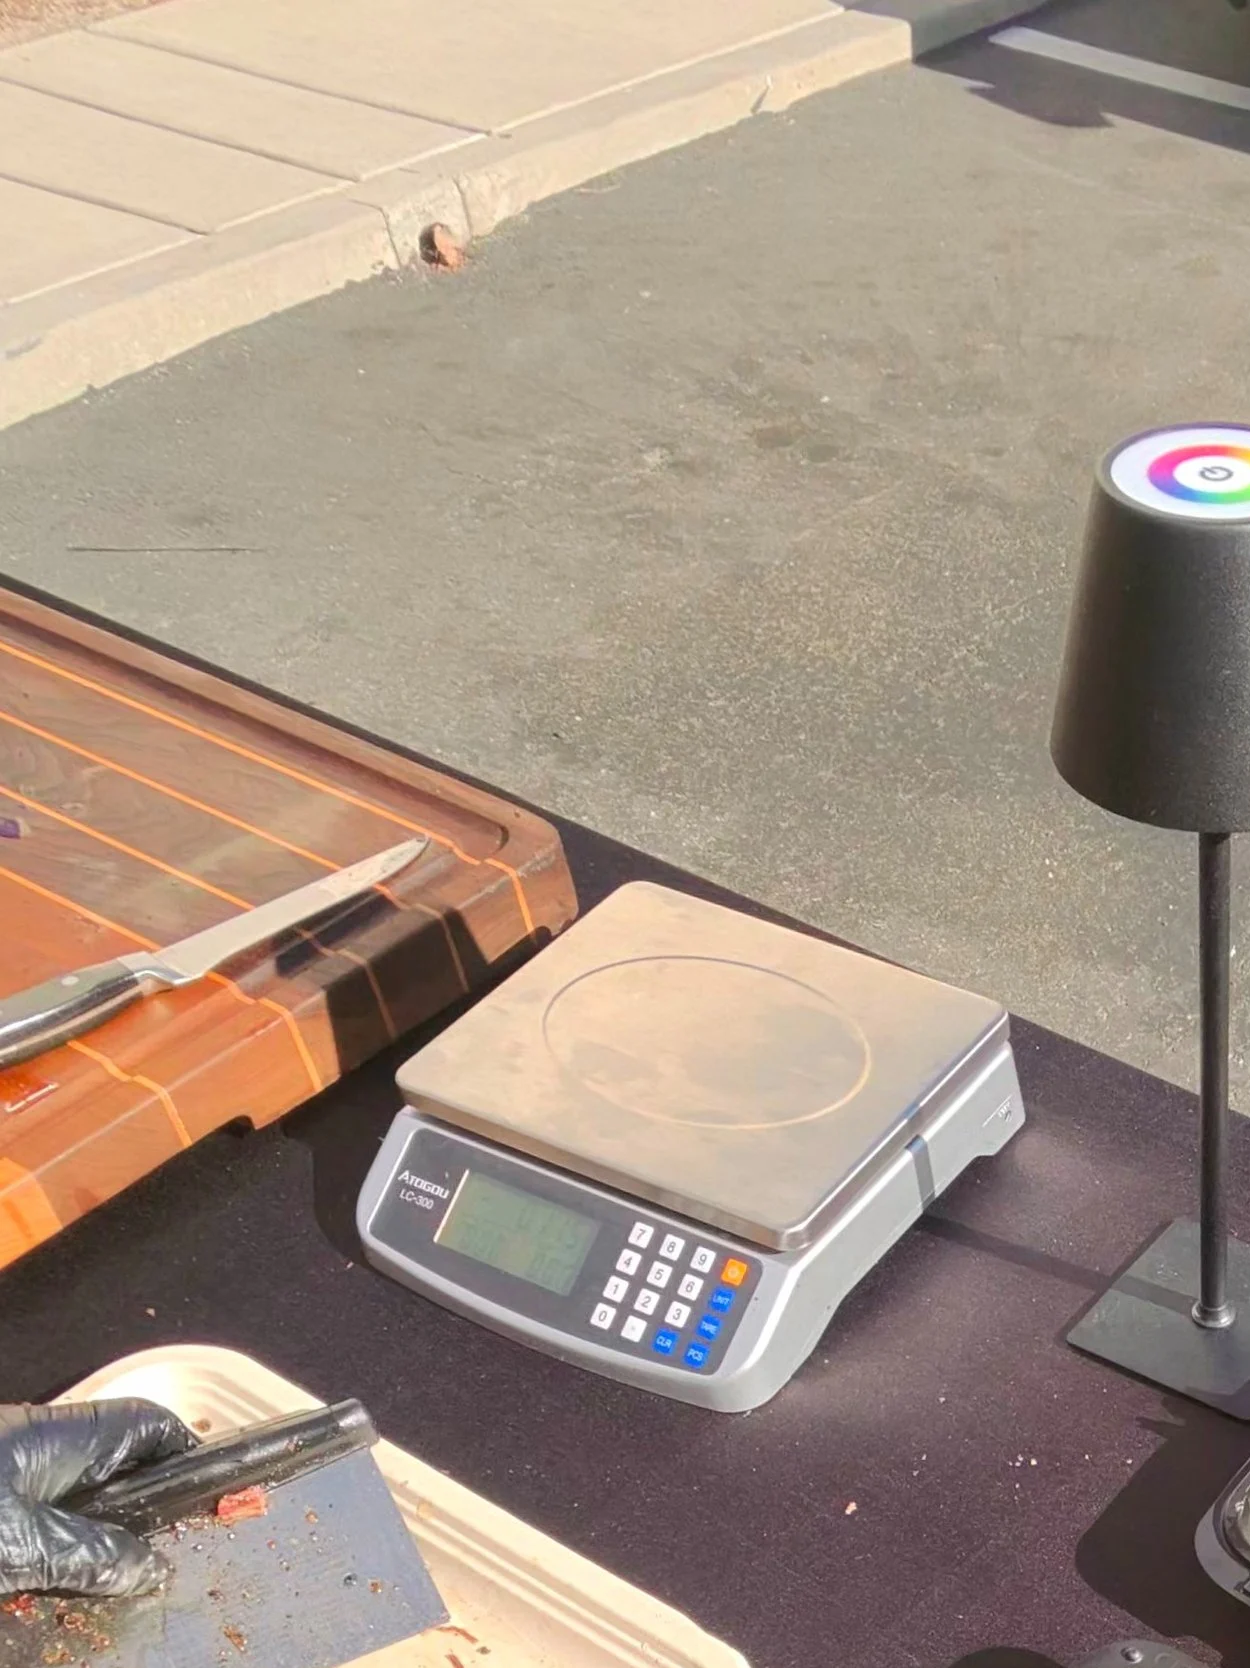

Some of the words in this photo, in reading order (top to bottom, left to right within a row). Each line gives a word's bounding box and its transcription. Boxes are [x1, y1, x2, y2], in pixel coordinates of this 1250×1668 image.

[398, 1170, 449, 1199] ATOGOU
[400, 1189, 434, 1209] LC-300
[636, 1228, 646, 1241] 7
[667, 1241, 677, 1254] 8
[698, 1253, 708, 1266] 9
[624, 1256, 633, 1268] 4
[654, 1268, 665, 1281] 5
[685, 1281, 695, 1294] 6
[612, 1283, 620, 1296] 1
[641, 1295, 652, 1309] 2
[672, 1308, 682, 1321] 3
[598, 1310, 608, 1323] 0
[656, 1335, 673, 1349] CLR
[687, 1348, 704, 1361] PCS
